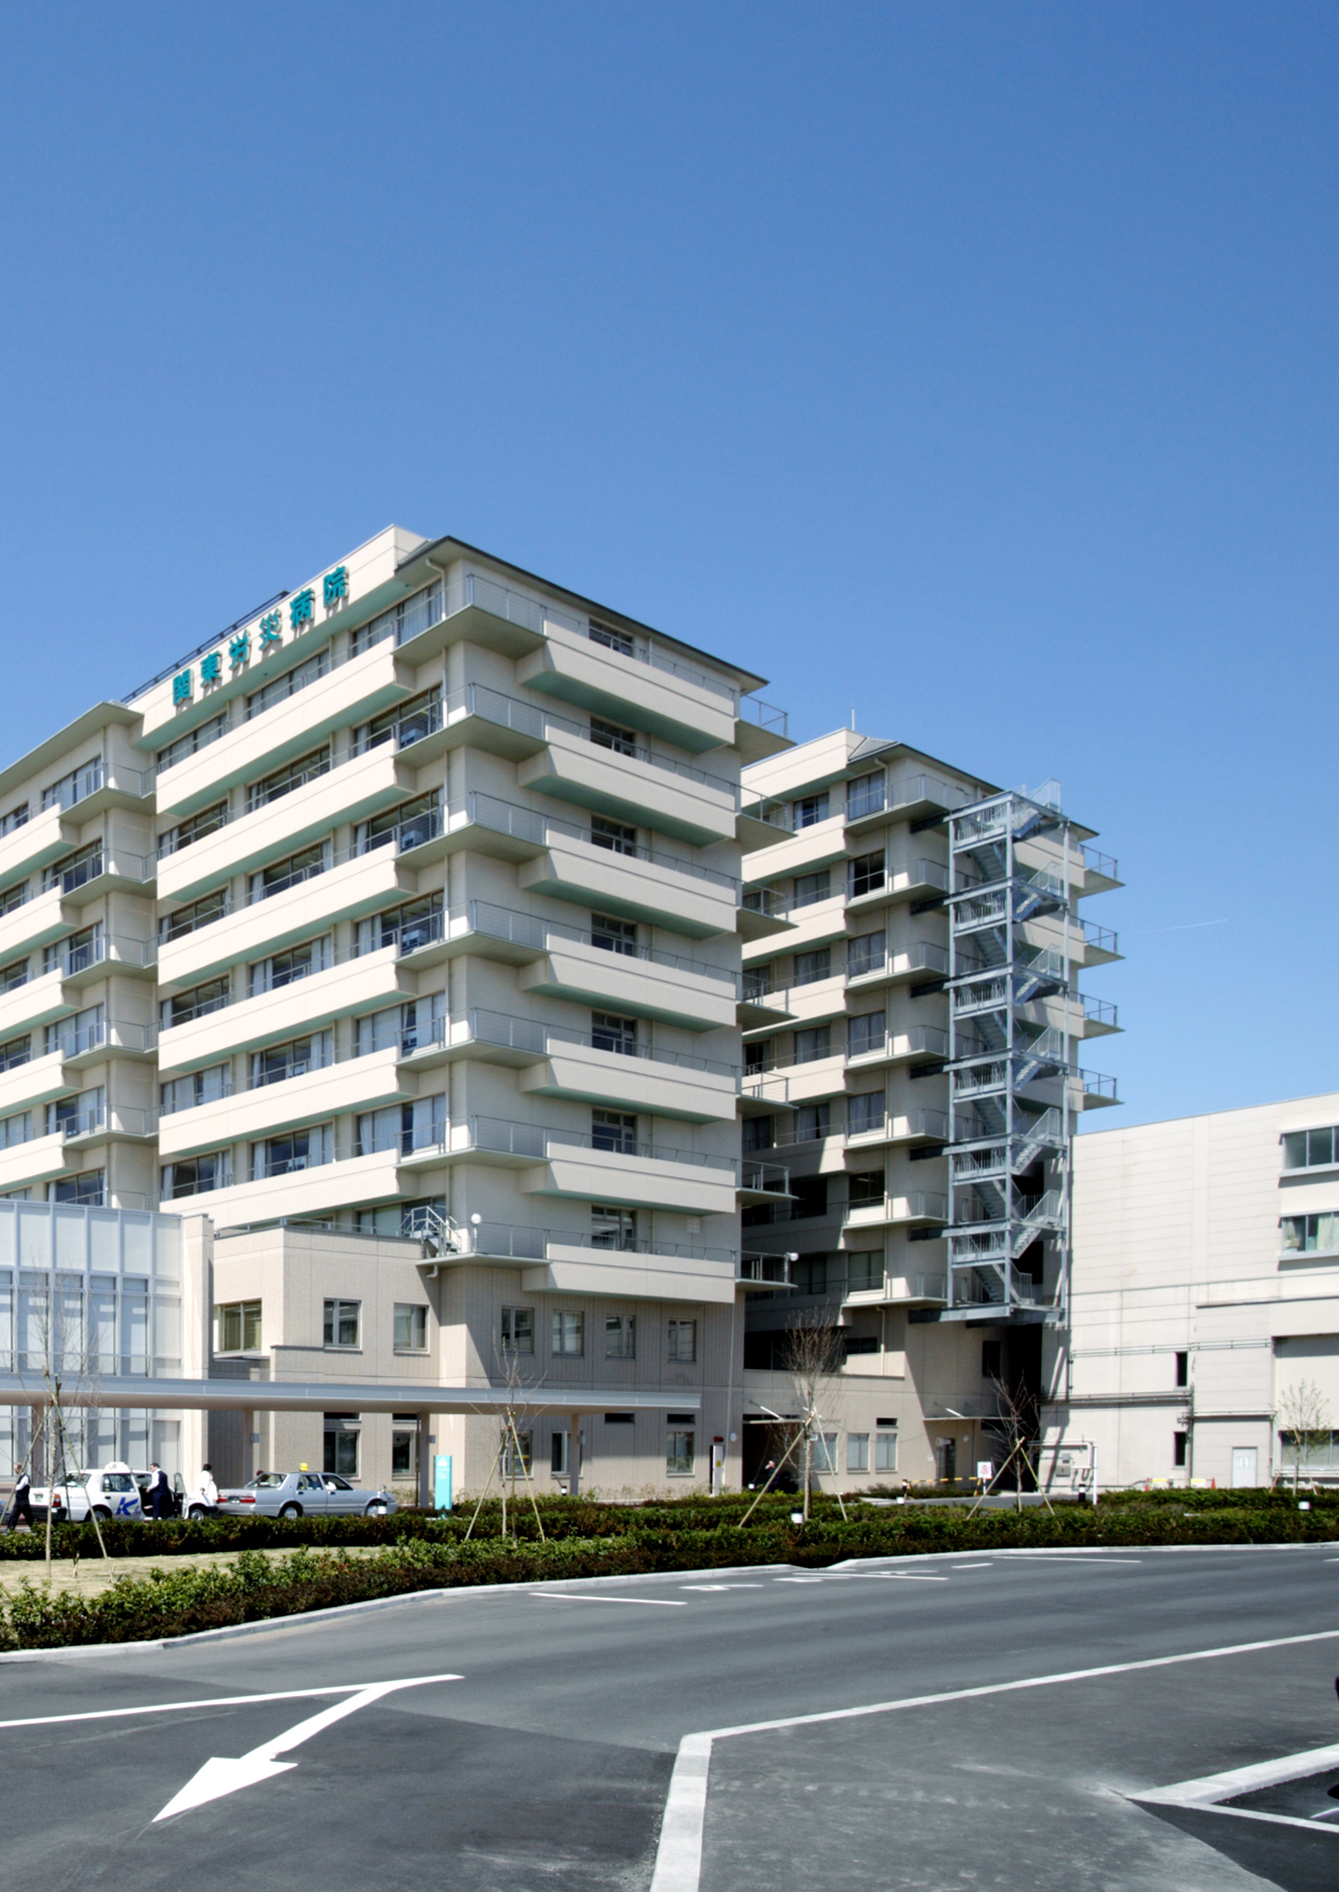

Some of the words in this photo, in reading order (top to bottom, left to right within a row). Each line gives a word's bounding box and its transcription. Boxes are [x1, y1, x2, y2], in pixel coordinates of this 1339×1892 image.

[172, 565, 348, 706] 関東労災病院
